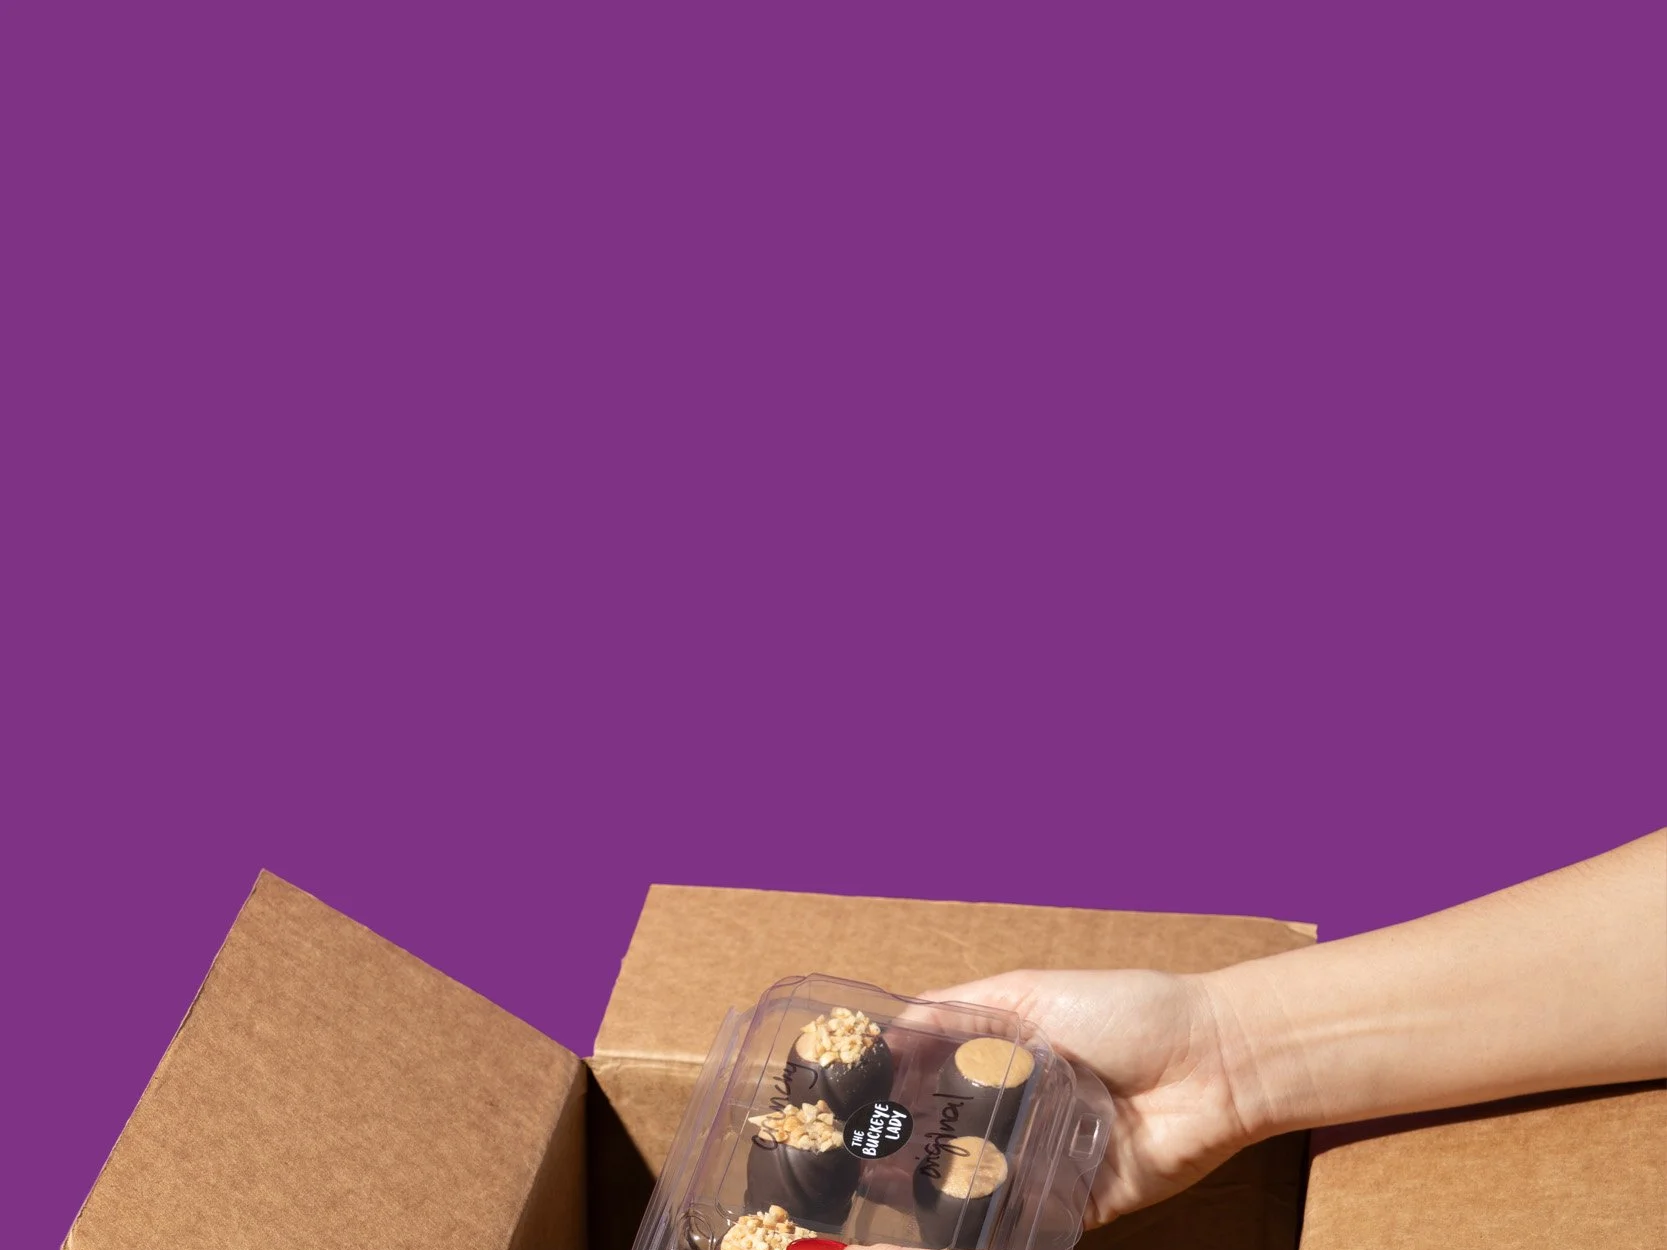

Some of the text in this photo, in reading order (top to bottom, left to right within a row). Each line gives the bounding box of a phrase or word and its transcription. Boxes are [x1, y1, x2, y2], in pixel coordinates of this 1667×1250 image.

[851, 1129, 865, 1147] THE
[862, 1103, 890, 1156] BUCKEYE
[884, 1110, 907, 1140] LADY
